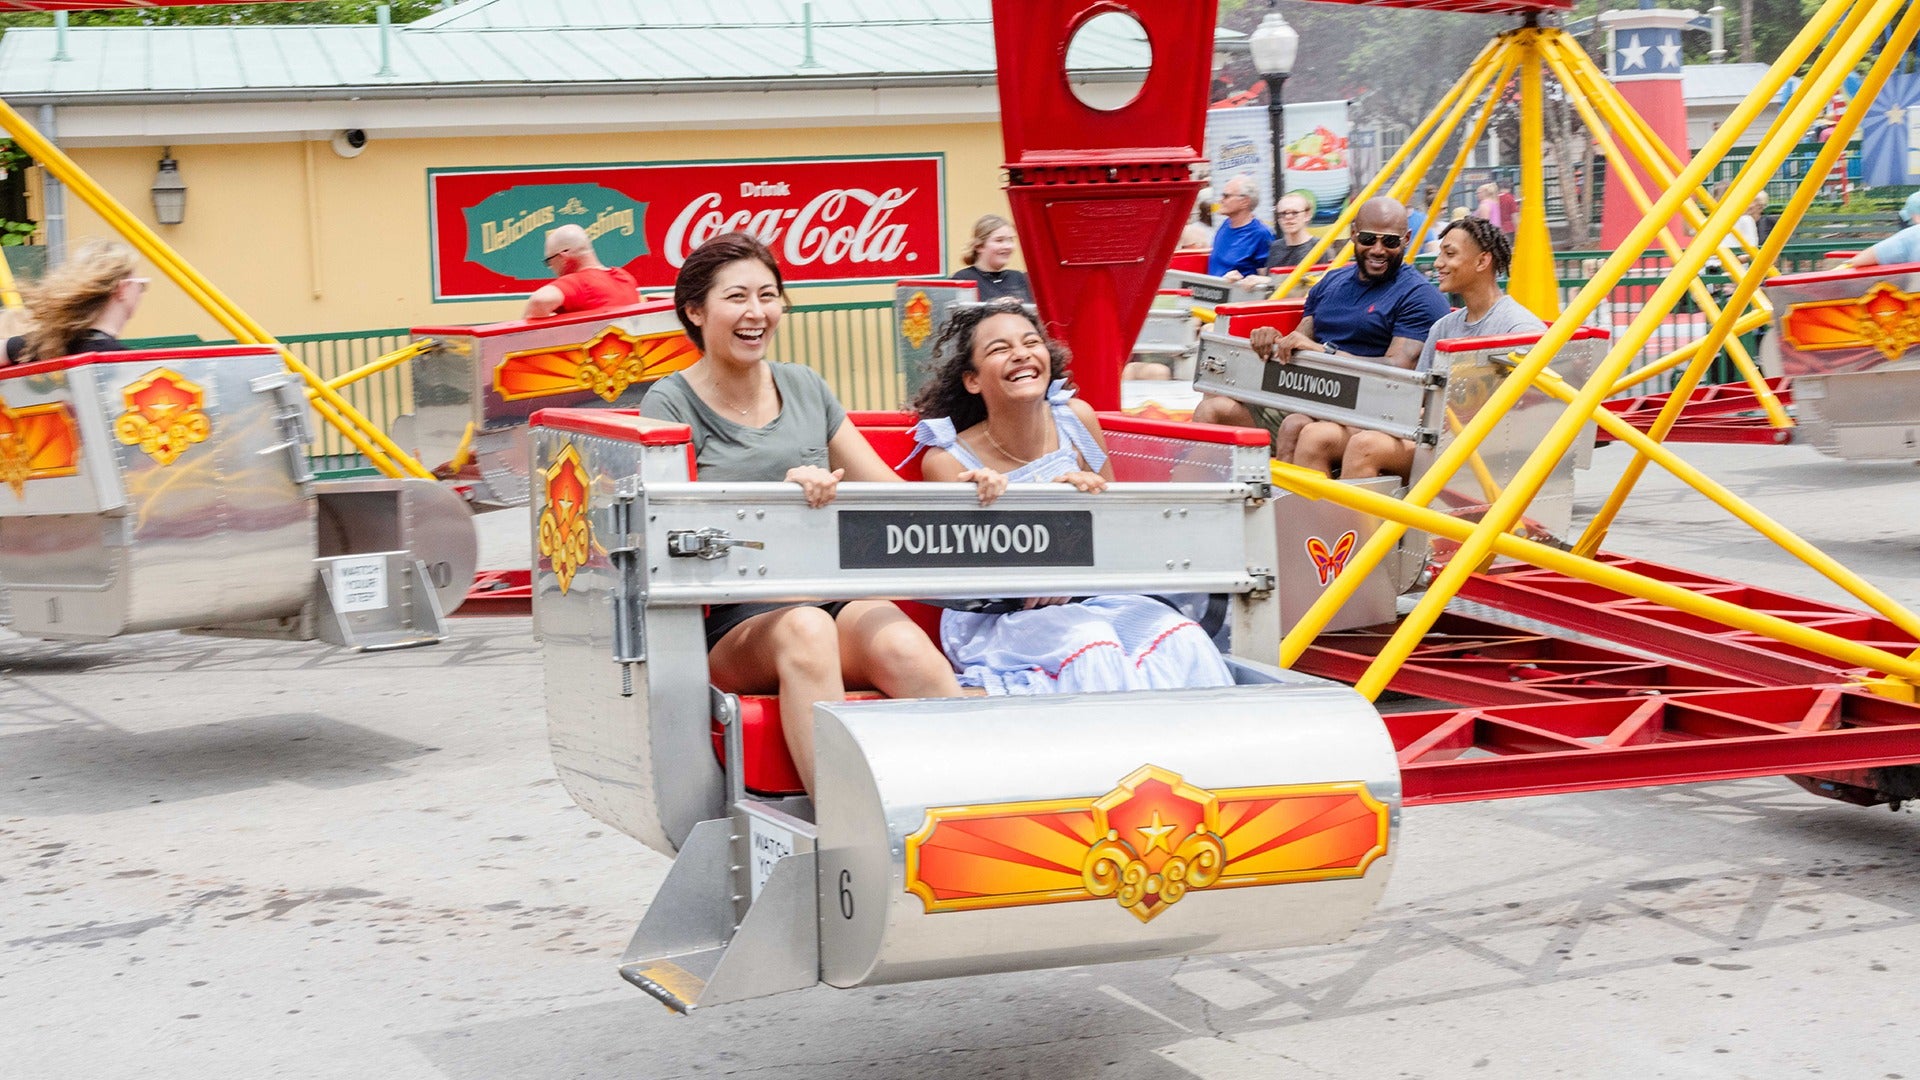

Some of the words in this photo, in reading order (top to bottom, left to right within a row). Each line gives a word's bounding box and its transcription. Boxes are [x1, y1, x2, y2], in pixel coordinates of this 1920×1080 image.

[740, 181, 791, 198] Drink
[481, 205, 555, 254] Delicious
[1277, 370, 1341, 398] DOLLYWOOD
[886, 524, 1050, 554] DOLLYWOOD
[839, 869, 854, 920] 6
